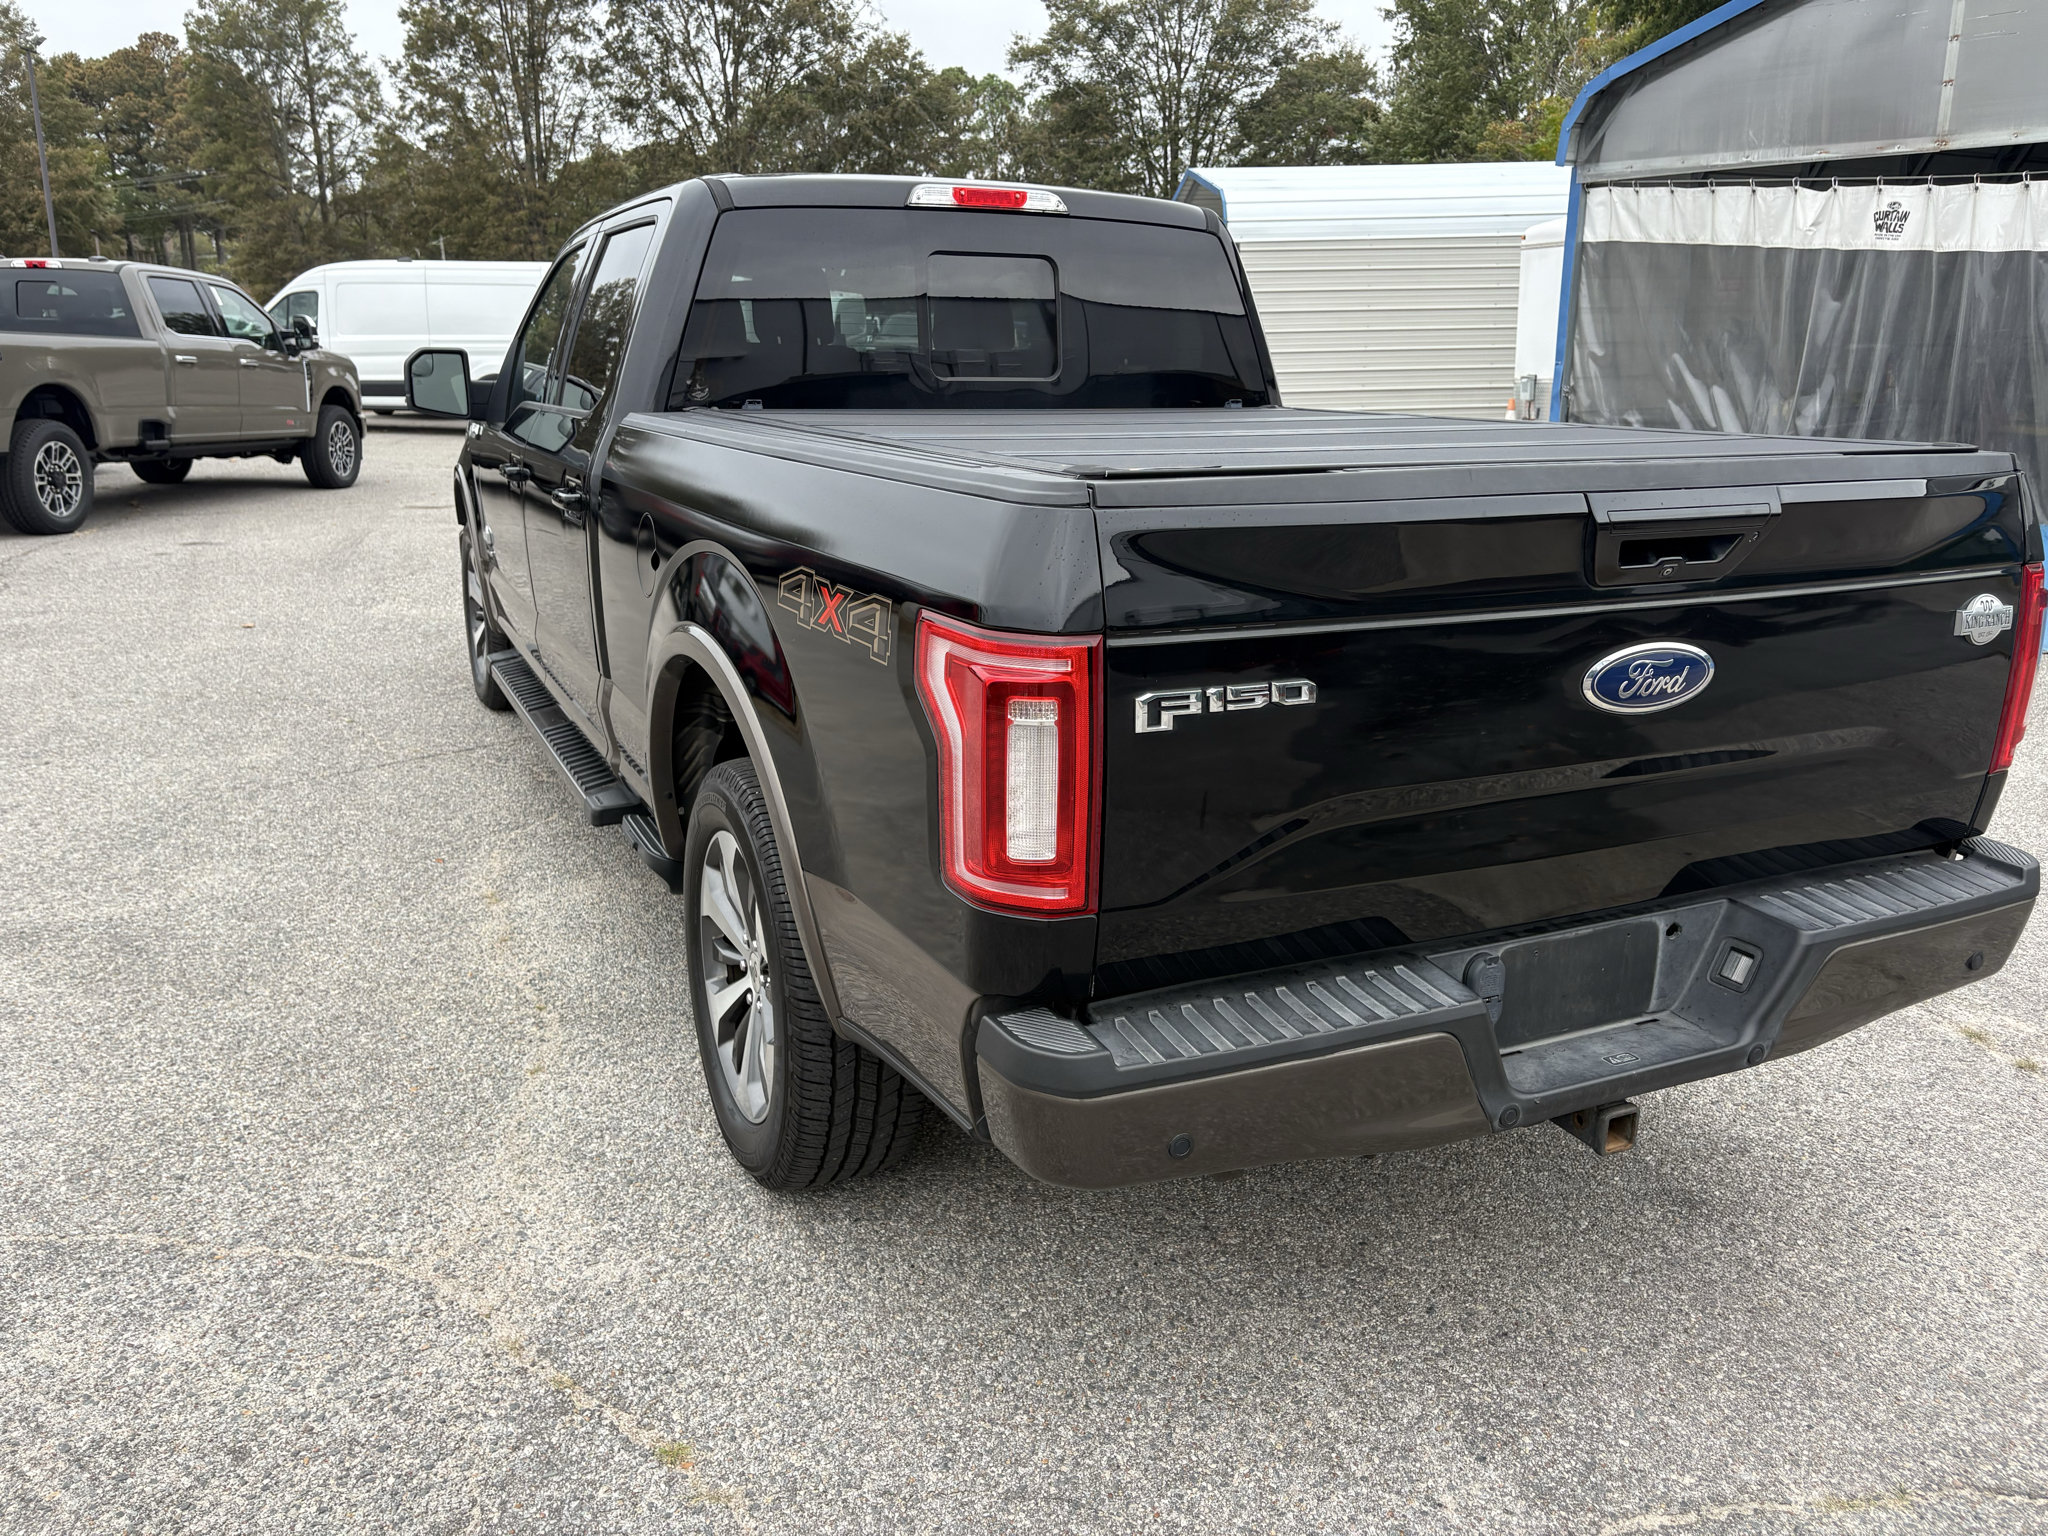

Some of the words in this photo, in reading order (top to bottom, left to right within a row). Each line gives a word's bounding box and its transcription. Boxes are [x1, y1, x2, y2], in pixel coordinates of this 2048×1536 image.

[1873, 209, 1911, 224] CURTAIN
[1875, 221, 1905, 234] WALLS
[1964, 612, 1984, 630] KING
[1985, 608, 2012, 628] RANCH
[1618, 658, 1691, 700] Ford
